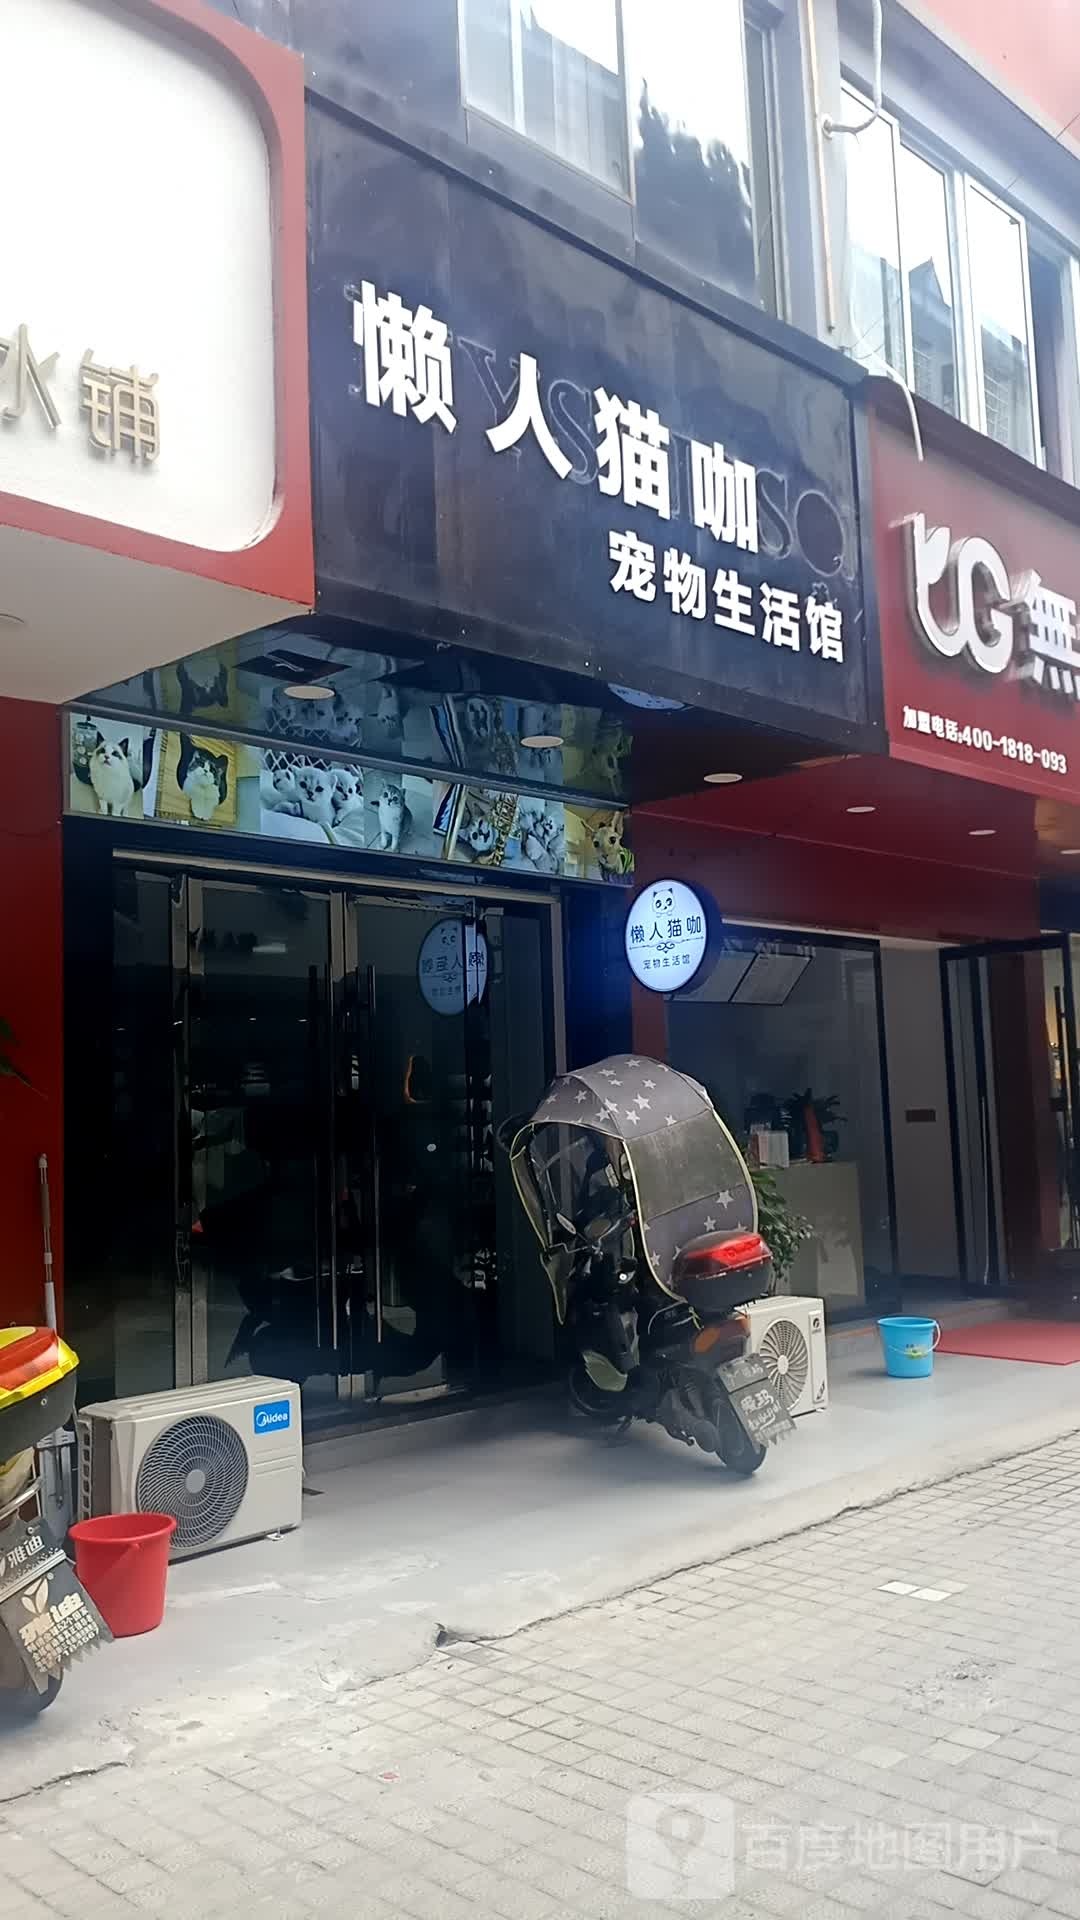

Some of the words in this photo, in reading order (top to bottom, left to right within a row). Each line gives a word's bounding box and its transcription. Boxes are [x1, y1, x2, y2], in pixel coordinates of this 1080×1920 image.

[353, 280, 759, 554] 懒人猫咖
[608, 531, 845, 664] 宠物生活馆
[631, 915, 702, 944] 懒人猫咖
[643, 953, 690, 970] 宠物生活馆
[256, 1411, 288, 1427] Midea
[6, 1535, 45, 1568] 雅迪
